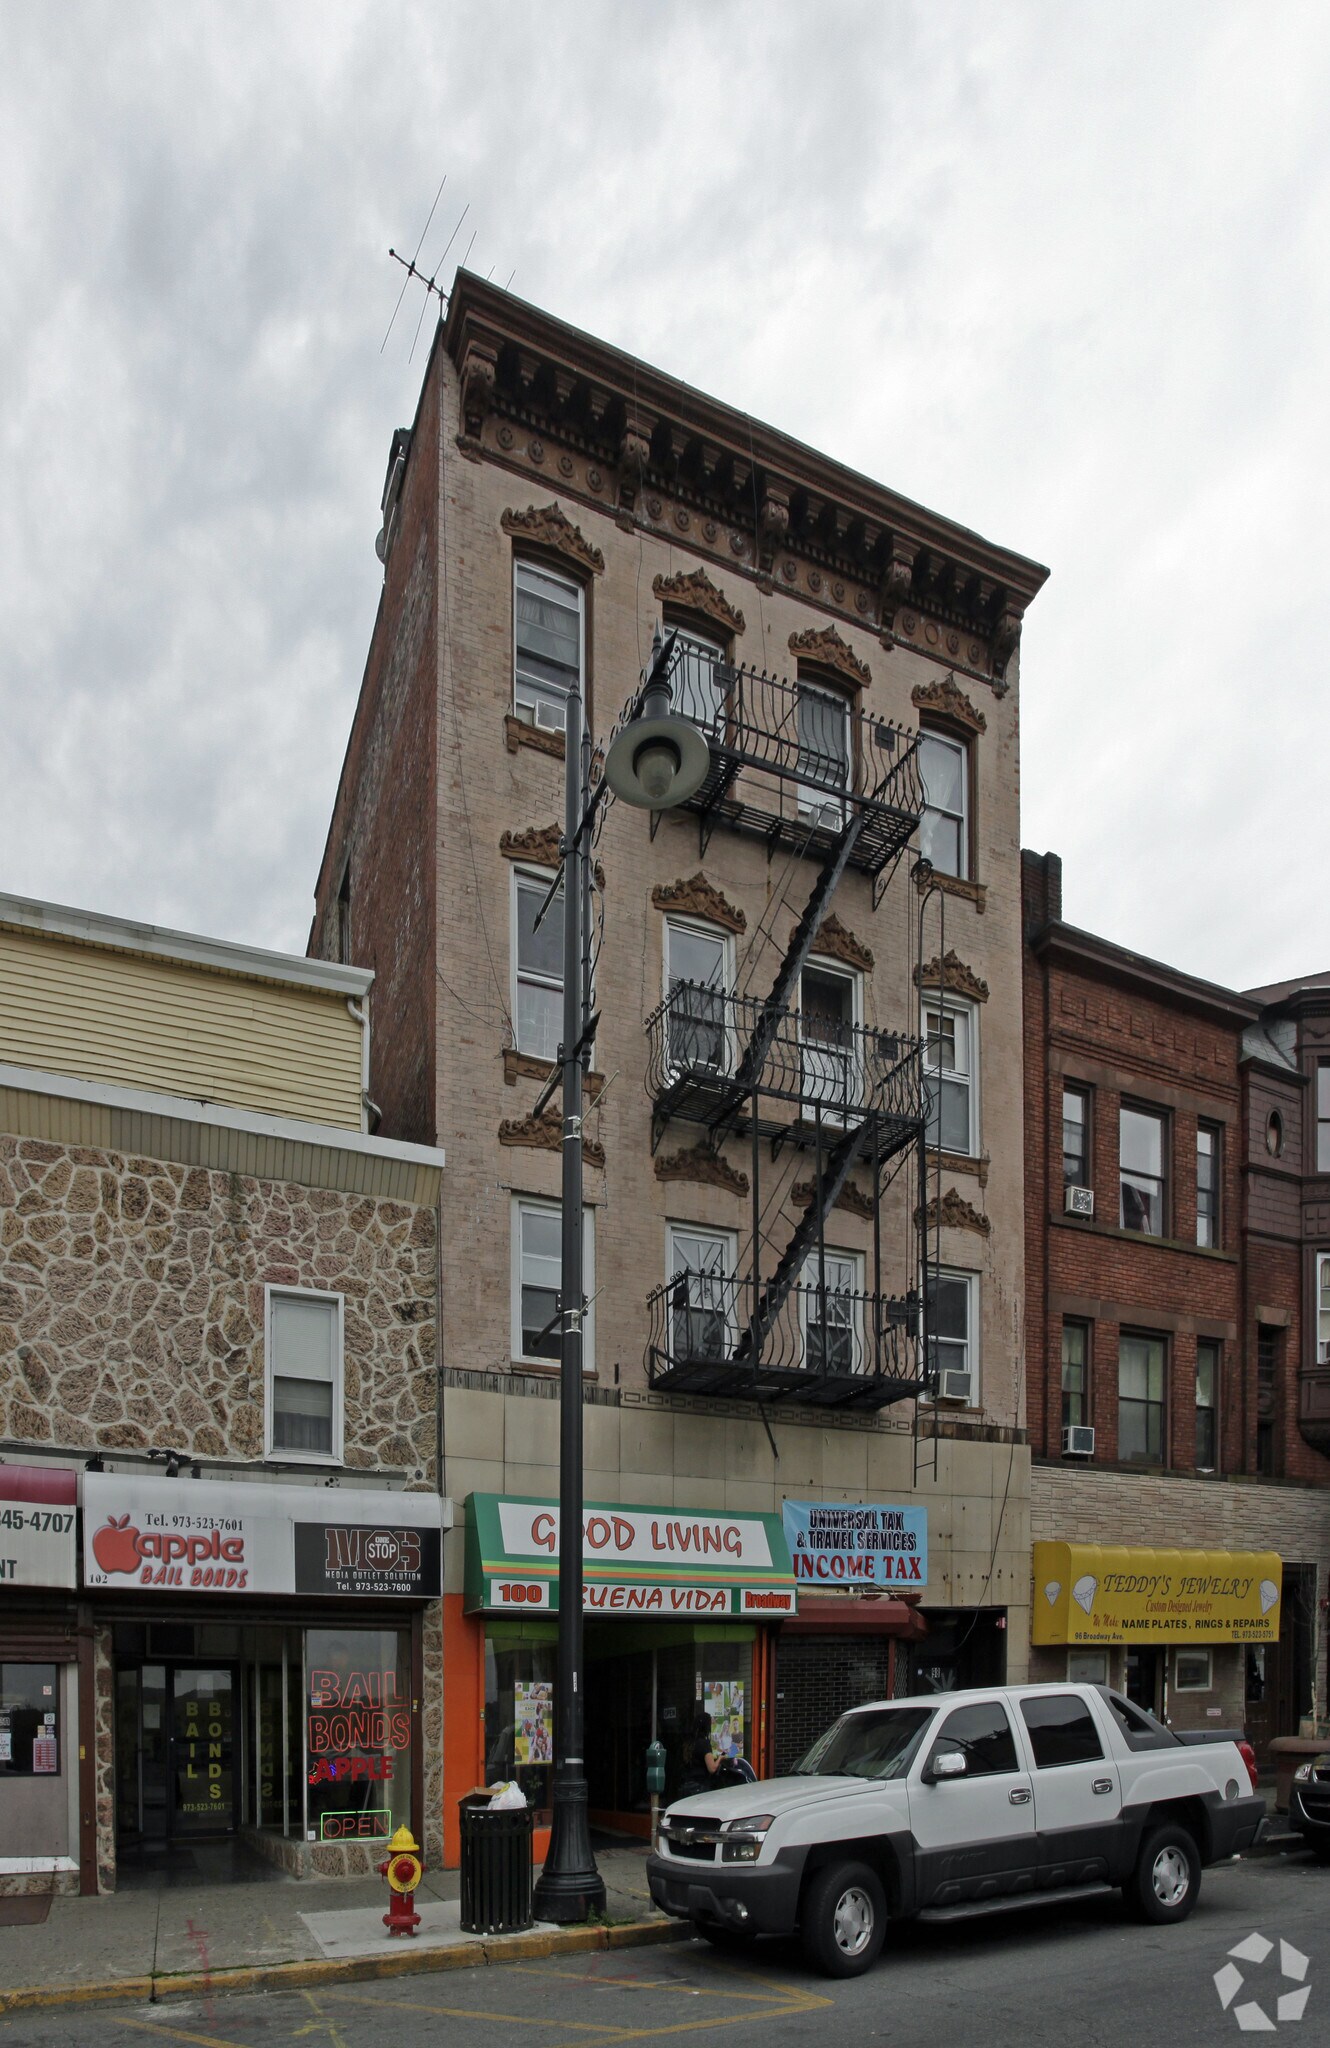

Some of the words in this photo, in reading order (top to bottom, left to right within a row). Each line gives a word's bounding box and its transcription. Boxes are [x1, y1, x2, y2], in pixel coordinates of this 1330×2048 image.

[0, 1509, 74, 1533] 45-4707
[145, 1514, 168, 1526] Tel.
[172, 1515, 243, 1531] 973-523-7601
[810, 1509, 877, 1530] UNIVERSAL
[880, 1511, 904, 1531] TAX
[531, 1513, 636, 1551] GOD
[651, 1521, 742, 1558] LIVING
[796, 1531, 806, 1549] &
[808, 1530, 855, 1550] TRAVEL
[857, 1531, 917, 1552] SERVICES
[136, 1529, 244, 1565] apple
[368, 1543, 397, 1559] STOP
[140, 1565, 183, 1586] BAIL
[190, 1567, 249, 1588] BONDS
[325, 1570, 349, 1579] MEDIA
[352, 1571, 381, 1580] OUTLET
[384, 1573, 421, 1581] SOLUTION
[793, 1554, 875, 1579] INCOME
[883, 1556, 922, 1579] TAX
[89, 1574, 108, 1584] 102
[336, 1581, 352, 1591] Tel.
[355, 1582, 411, 1592] 973-523-7600
[1103, 1574, 1172, 1598] TEDDY'S
[1176, 1576, 1254, 1599] JEWELRY
[499, 1584, 543, 1603] 100
[670, 1588, 726, 1611] VIDA
[744, 1591, 792, 1610] Broadway
[1145, 1600, 1167, 1613] Custom
[1167, 1600, 1192, 1616] Designed
[1191, 1601, 1213, 1615] Jewelry
[1121, 1619, 1150, 1629] NAME
[1195, 1619, 1223, 1629] RINGS
[1225, 1620, 1231, 1628] &
[1233, 1619, 1270, 1628] REPAIRS
[1083, 1632, 1111, 1642] Broadway
[1112, 1632, 1125, 1640] Ave.
[311, 1670, 409, 1709] BAIL
[186, 1701, 199, 1778] BAIL
[308, 1711, 410, 1753] BONDS
[208, 1701, 222, 1799] BONDS
[315, 1755, 394, 1782] APPLE
[323, 1817, 389, 1838] OPEN
